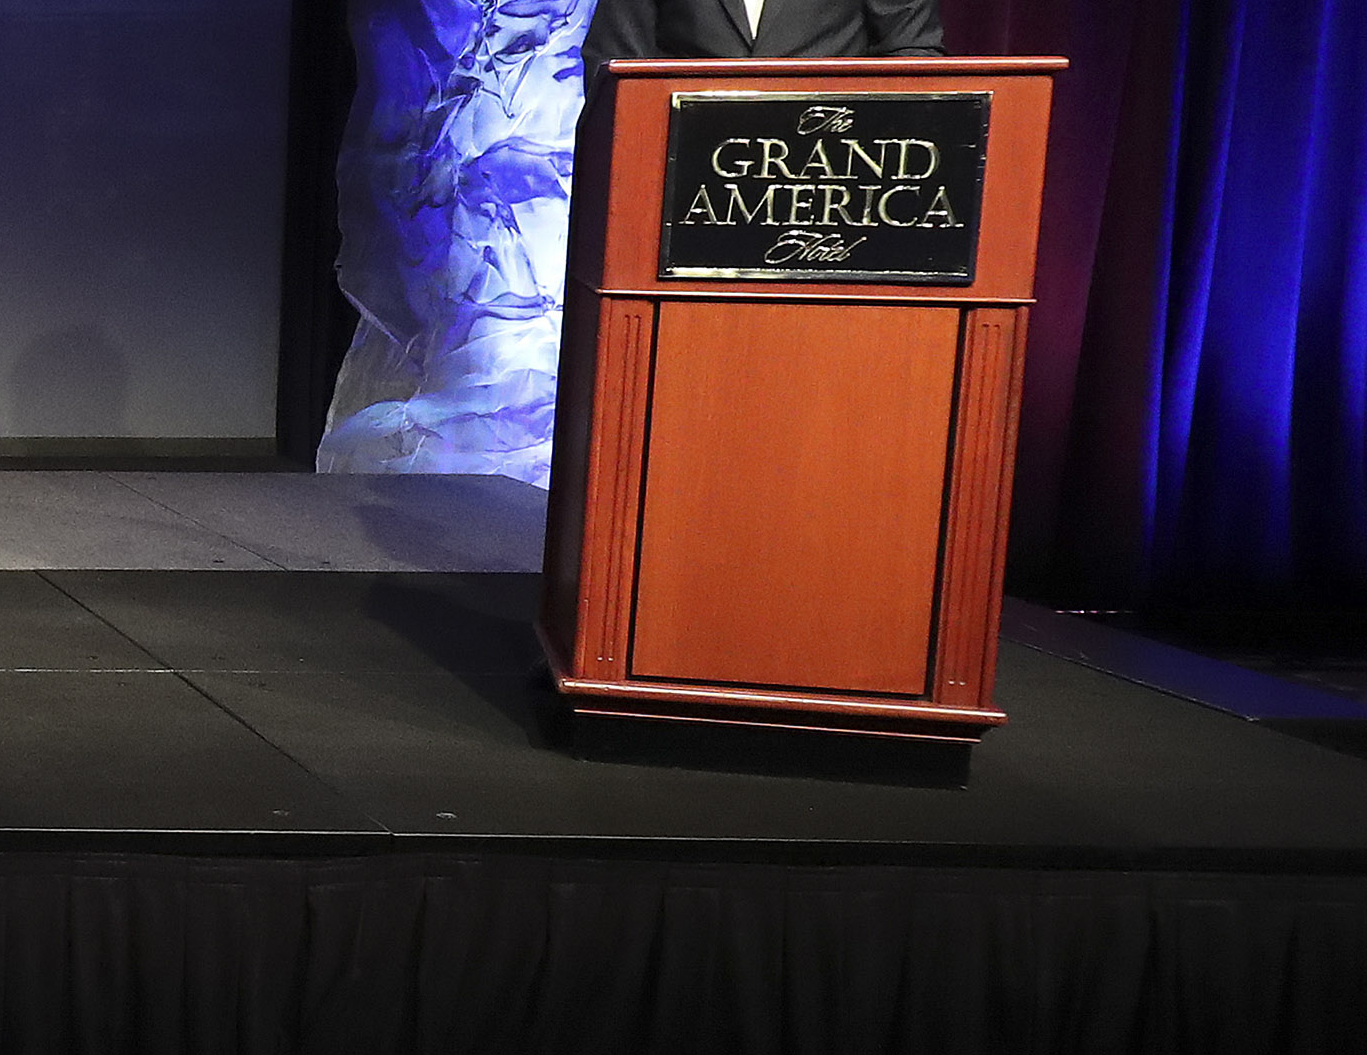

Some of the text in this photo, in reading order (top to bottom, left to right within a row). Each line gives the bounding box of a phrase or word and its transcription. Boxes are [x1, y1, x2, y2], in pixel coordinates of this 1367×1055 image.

[796, 106, 856, 135] The
[710, 138, 941, 180] GRAND
[678, 183, 965, 228] AMERICA
[763, 229, 868, 264] Hotel
